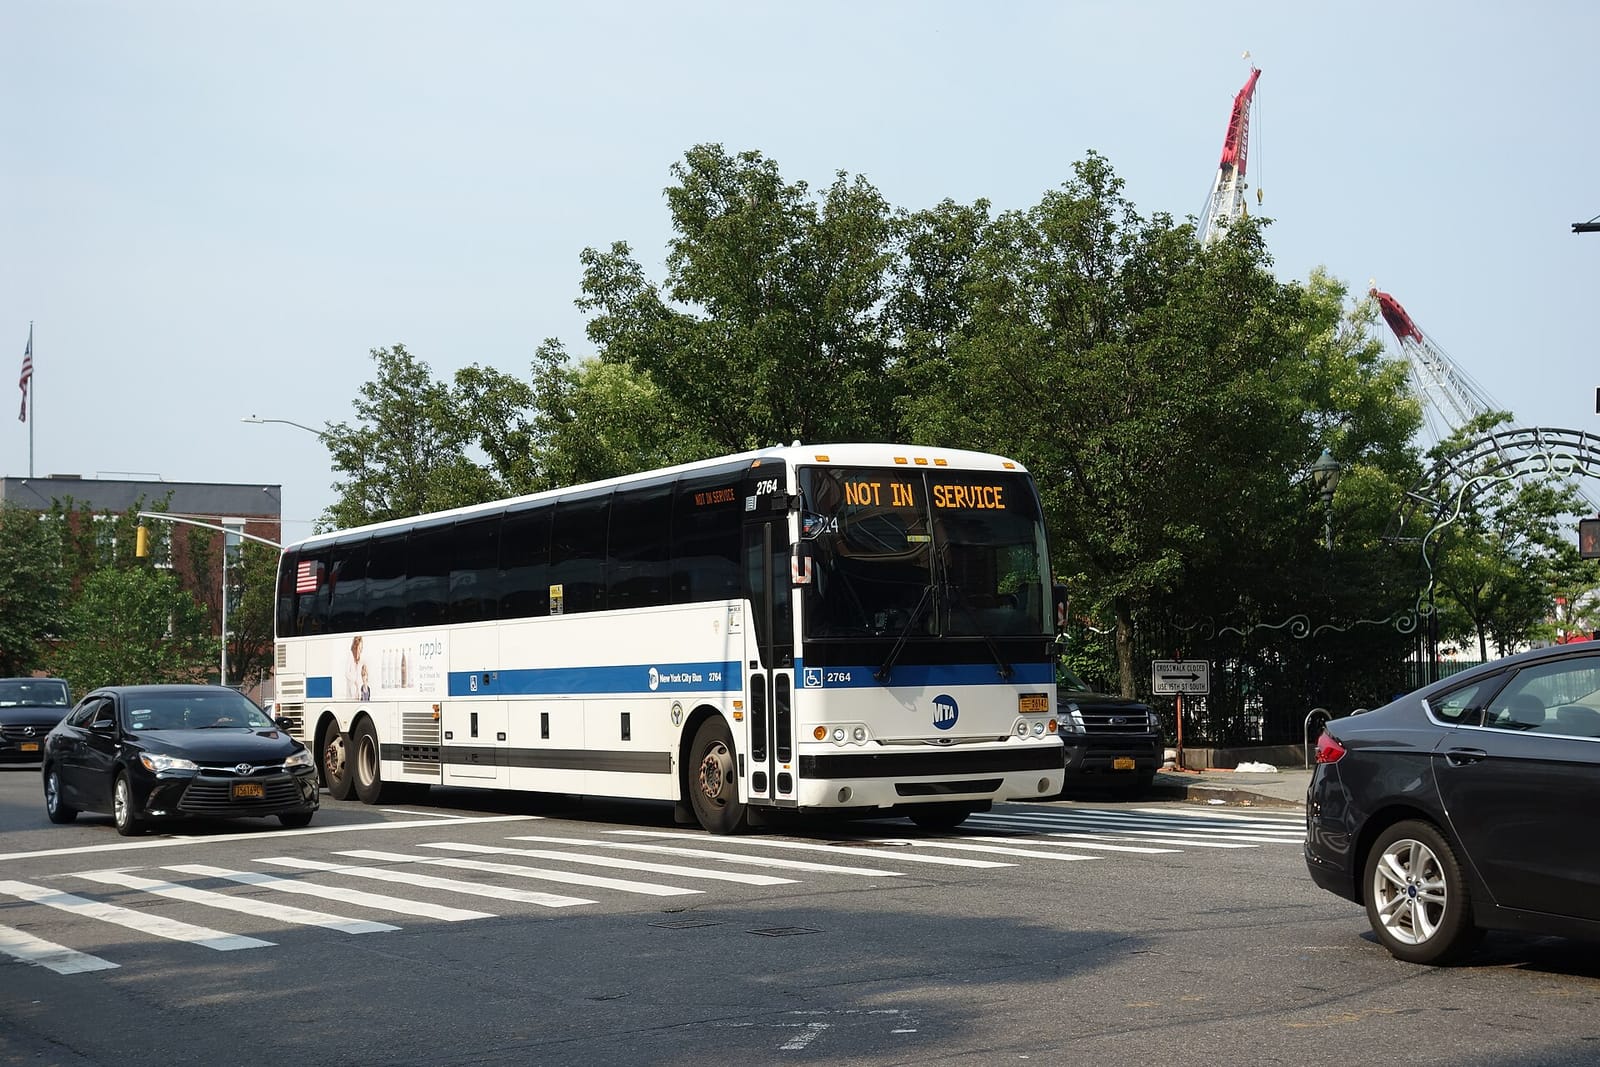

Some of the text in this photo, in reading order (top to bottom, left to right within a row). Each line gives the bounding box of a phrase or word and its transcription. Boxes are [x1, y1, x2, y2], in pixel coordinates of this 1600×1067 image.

[756, 478, 778, 496] 2764
[844, 481, 1006, 509] NOT IN SERVICE
[695, 492, 705, 506] NOT
[706, 492, 713, 504] IN
[712, 488, 735, 504] SERVICE
[419, 637, 442, 660] ripple
[708, 672, 722, 682] 2764
[1156, 664, 1205, 672] CROSSWALK CLOSED
[659, 674, 670, 683] New
[670, 673, 681, 683] York
[681, 673, 692, 684] City
[692, 673, 702, 682] Bus
[827, 672, 851, 683] 2764
[932, 702, 955, 724] MTA
